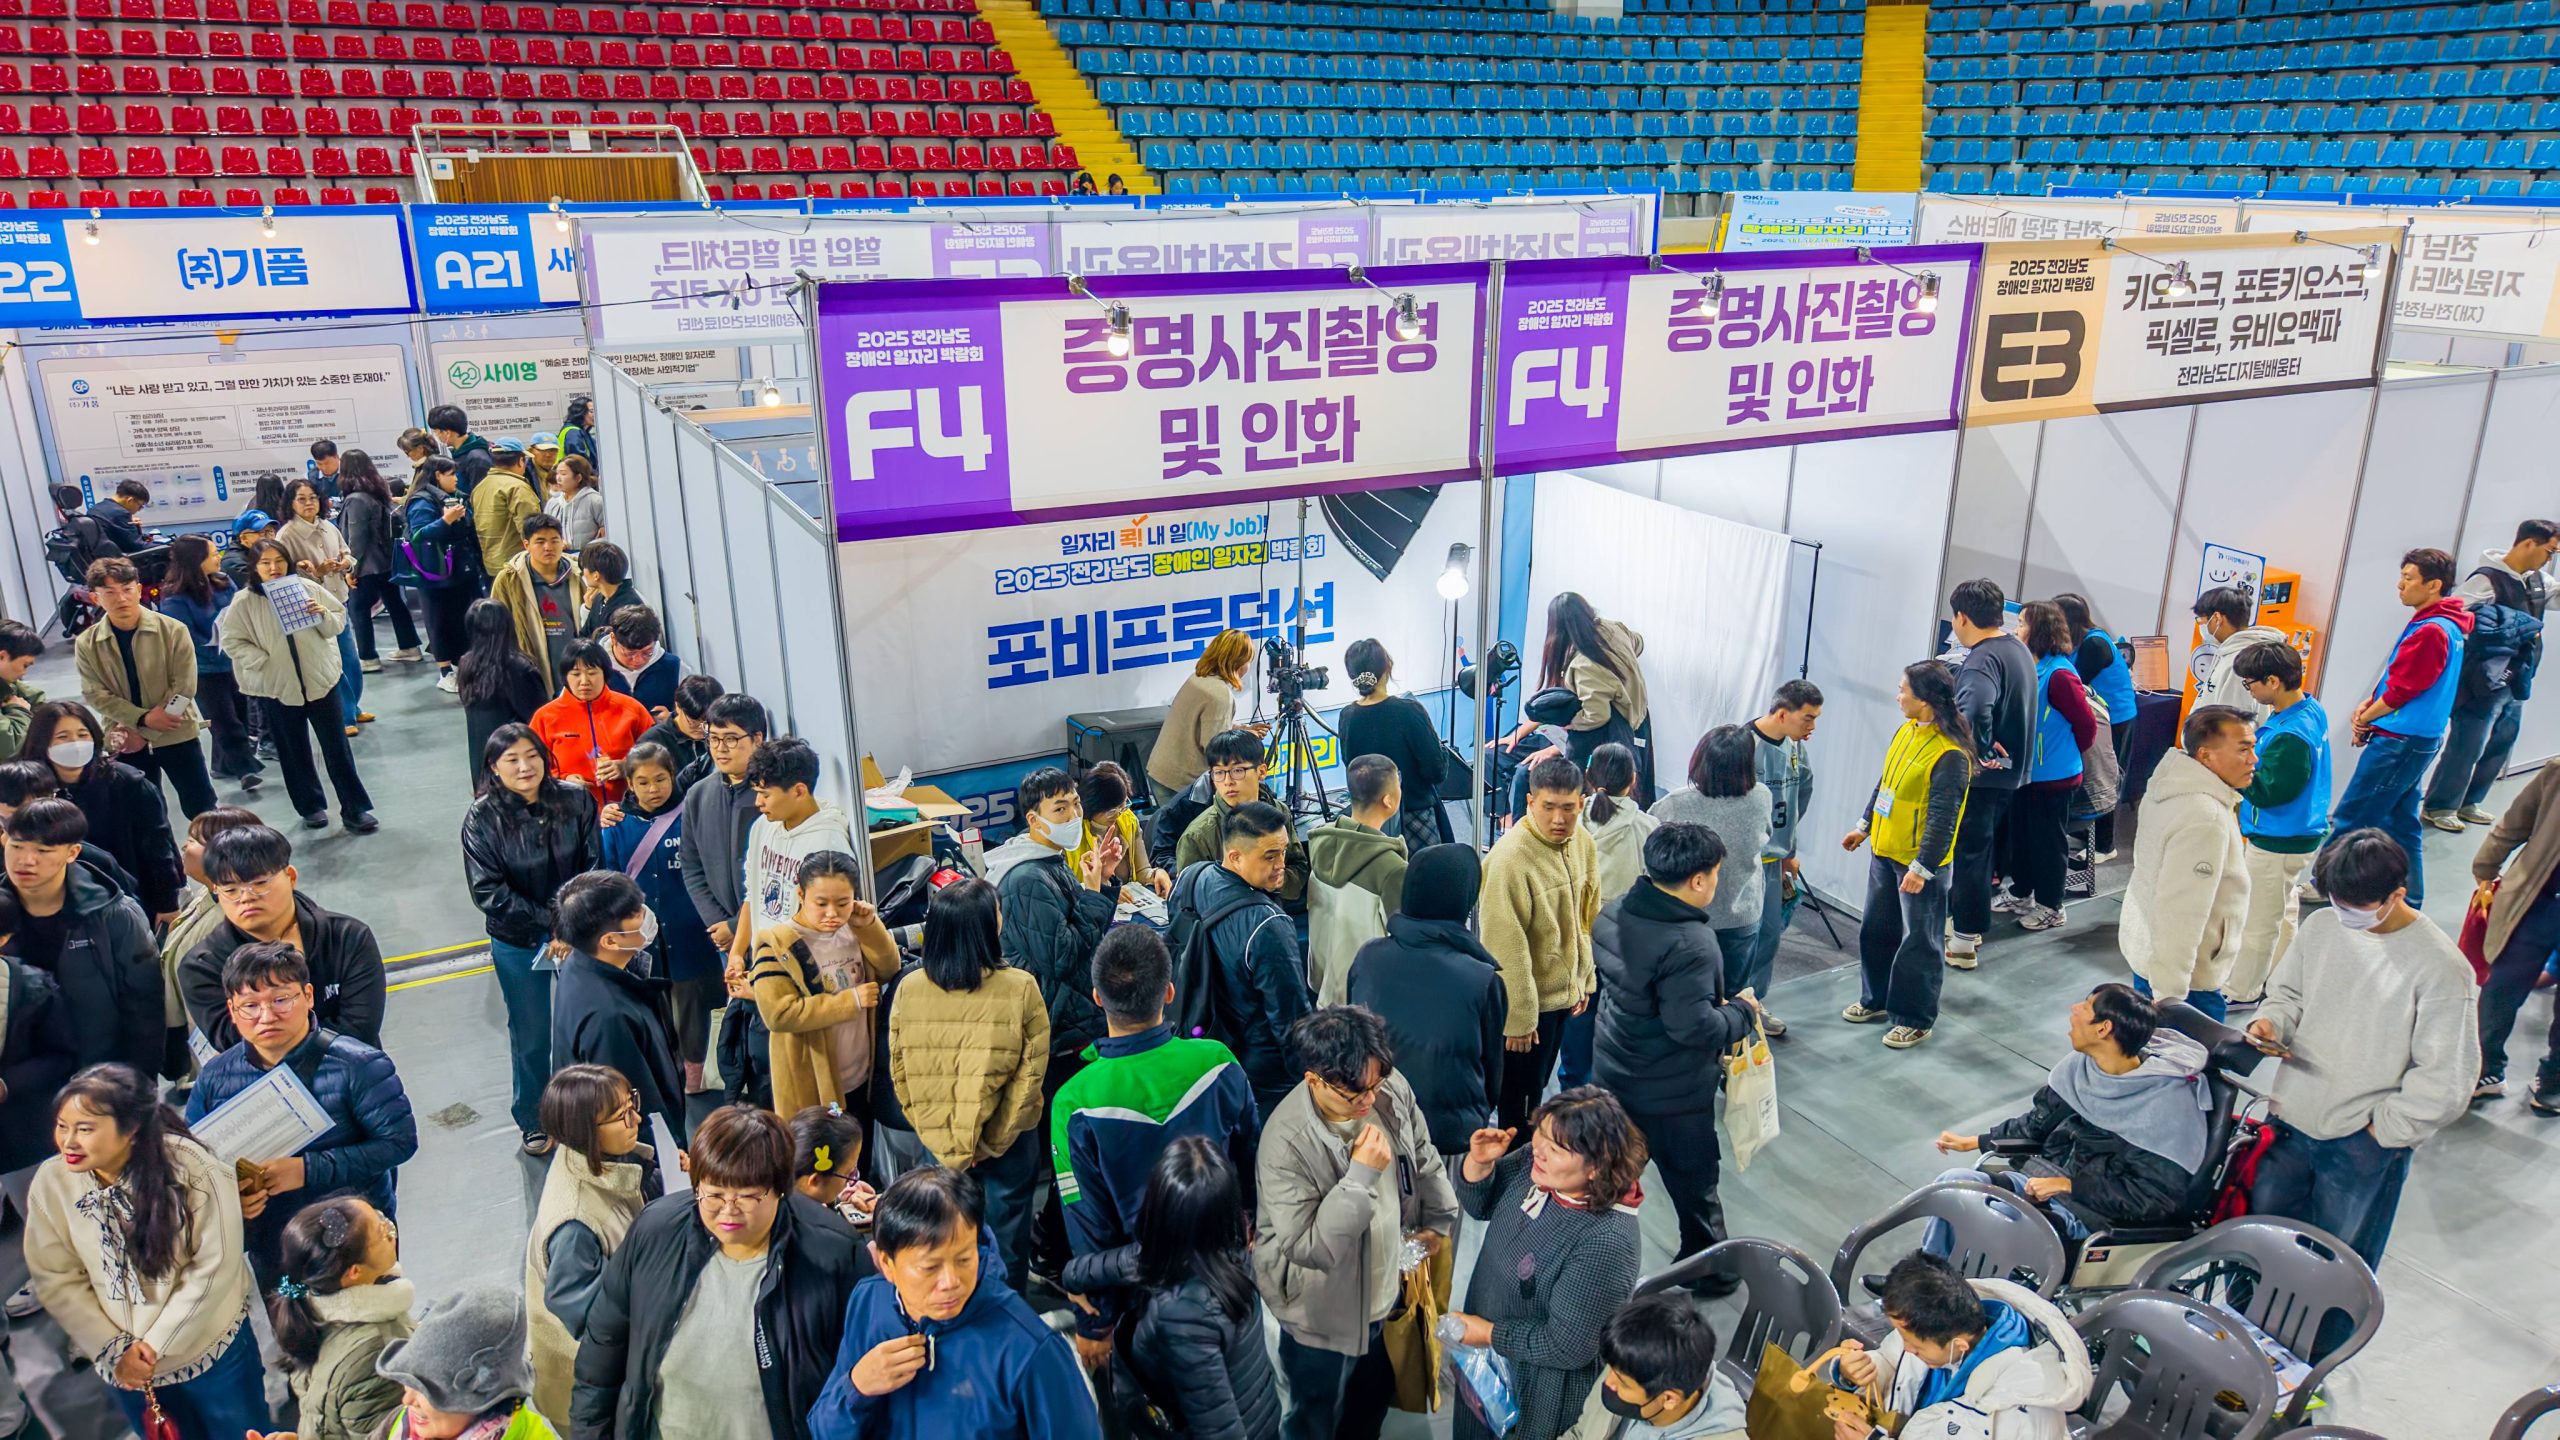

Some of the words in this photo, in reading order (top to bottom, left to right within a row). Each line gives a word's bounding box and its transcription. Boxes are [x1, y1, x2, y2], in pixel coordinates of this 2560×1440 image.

[428, 226, 458, 236] 장애인
[459, 226, 488, 236] 일자리
[489, 225, 519, 236] 박람회
[435, 215, 469, 225] 2025
[470, 214, 509, 225] 전라남도
[16, 233, 51, 245] 박람회
[178, 247, 309, 290] (주)기품
[435, 250, 524, 290] A21
[2008, 260, 2047, 276] 2025
[2047, 258, 2090, 275] 전라남도
[1997, 279, 2030, 296] 장애인
[2031, 277, 2063, 294] 일자리
[2065, 276, 2096, 293] 박람회
[2123, 270, 2226, 311] 키오스크,
[2232, 263, 2369, 304] 포토키오스크,
[1527, 299, 1564, 315] 2025
[1565, 296, 1607, 313] 전라남도
[1667, 278, 1940, 353] 증명사진촬영
[1518, 316, 1550, 331] 장애인
[1551, 314, 1582, 329] 일자리
[1583, 311, 1614, 327] 박람회
[2146, 317, 2222, 356] 픽셀로,
[2229, 308, 2342, 351] 유비오맥파
[857, 331, 910, 348] 2025
[911, 327, 971, 346] 전라남도
[1063, 301, 1440, 394] 증명사진촬영
[572, 356, 589, 367] 전하
[624, 352, 658, 364] 인식개선,
[659, 351, 683, 362] 장애인
[684, 349, 716, 361] 일자리로
[845, 350, 892, 368] 장애인
[894, 347, 938, 366] 일자리
[940, 345, 984, 363] 박람회
[1980, 309, 2086, 403] E3
[2177, 356, 2302, 386] 전라남도디지털배움터
[138, 383, 160, 395] 사랑
[162, 382, 185, 394] 받고
[187, 381, 213, 393] 있고,
[214, 380, 236, 391] 그럴
[238, 378, 260, 390] 만한
[263, 376, 294, 389] 가치가
[296, 375, 317, 387] 있는
[319, 373, 350, 386] 소중한
[483, 361, 538, 383] 사이영
[1508, 345, 1610, 427] F4
[1726, 361, 1774, 426] 및
[1786, 354, 1875, 421] 인화
[844, 385, 993, 482] F4
[1160, 404, 1223, 481] 및
[1241, 394, 1361, 473] 인화
[1061, 530, 1116, 556] 일자리
[1147, 525, 1165, 546] 내
[1223, 515, 1268, 537] Job)!
[995, 563, 1069, 595] 2025
[1069, 554, 1151, 585] 전라남도
[1152, 547, 1211, 576] 장애인
[1212, 543, 1268, 569] 일자리
